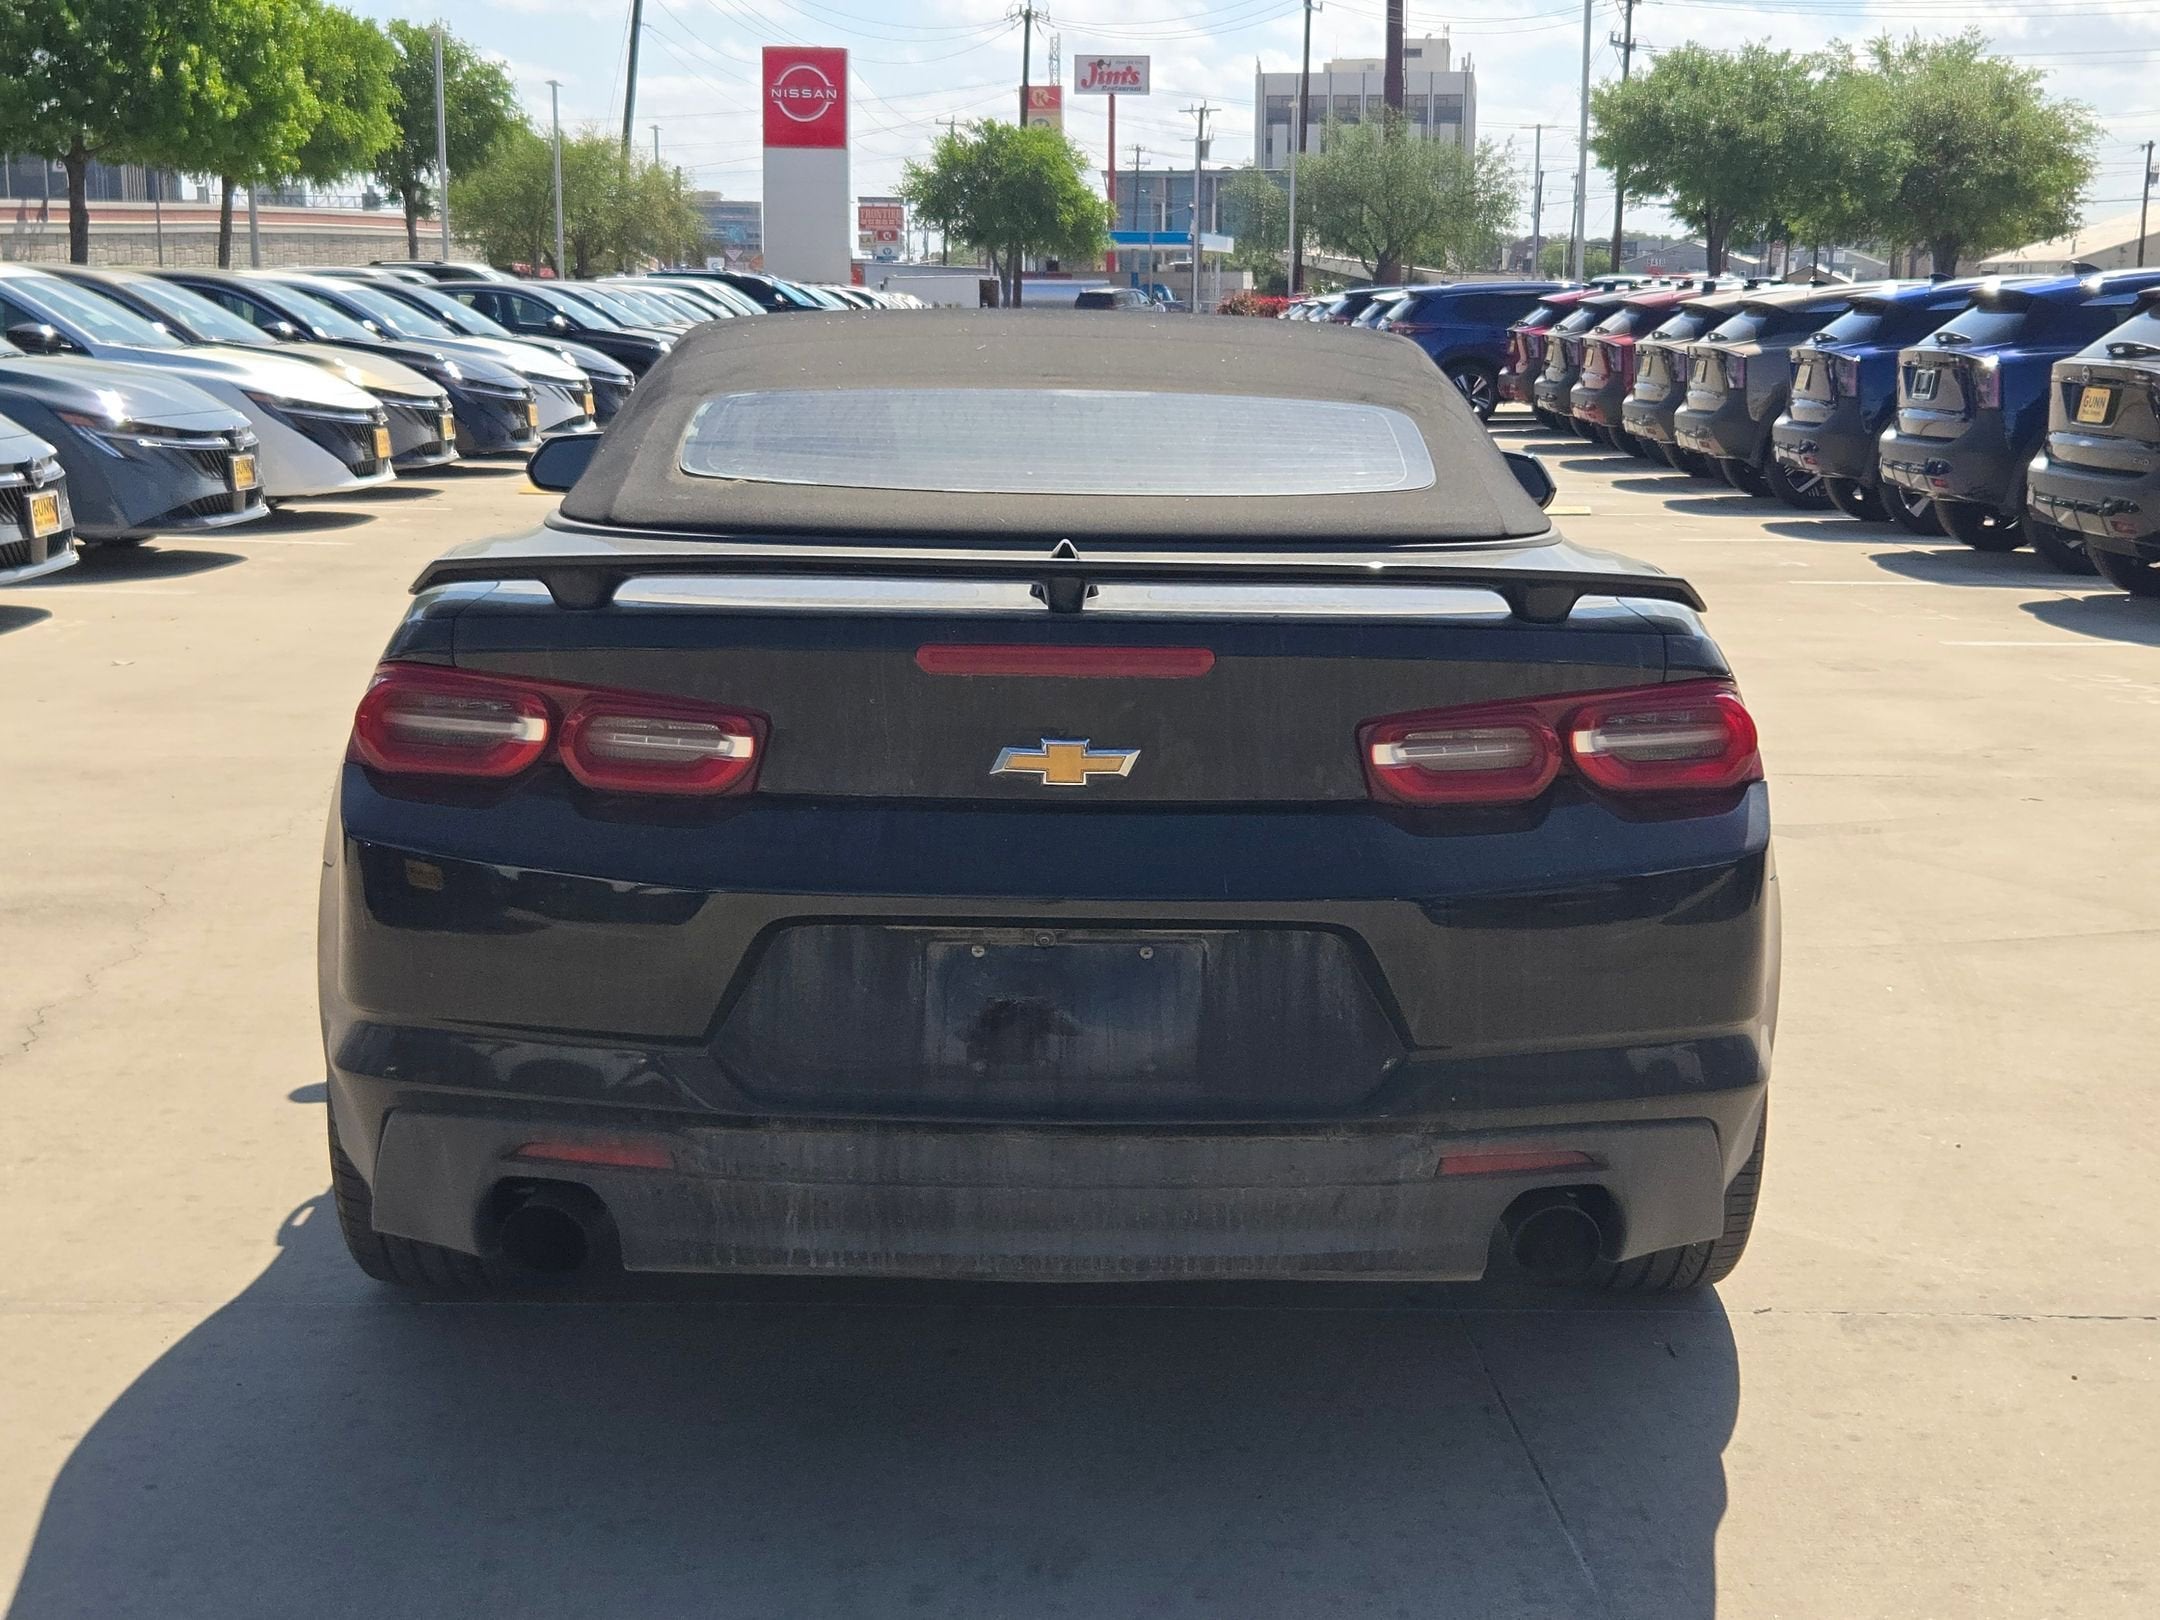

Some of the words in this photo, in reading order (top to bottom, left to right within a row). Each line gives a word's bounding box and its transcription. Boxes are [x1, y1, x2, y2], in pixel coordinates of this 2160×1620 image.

[1081, 61, 1140, 89] Jim's
[771, 88, 837, 99] NISSAN
[1036, 91, 1048, 105] K
[2084, 396, 2106, 408] GUNN
